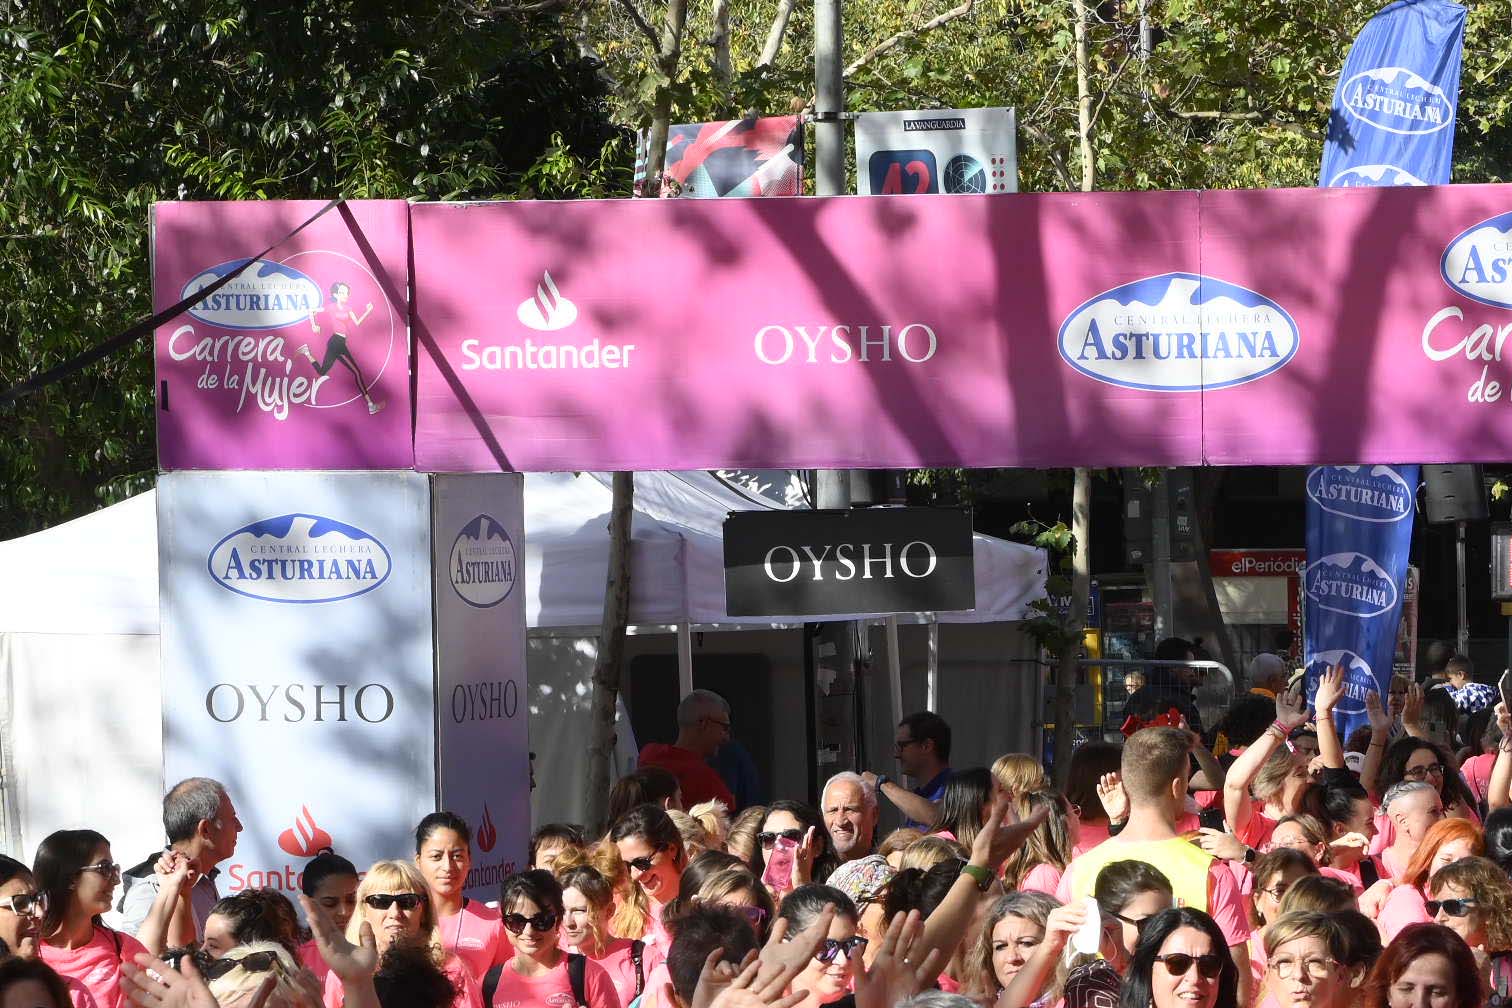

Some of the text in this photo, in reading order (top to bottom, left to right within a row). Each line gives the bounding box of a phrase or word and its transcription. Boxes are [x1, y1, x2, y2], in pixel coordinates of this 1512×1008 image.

[1351, 83, 1442, 123] ASTURIANA
[1077, 317, 1281, 361] ASTURIANA
[1113, 314, 1189, 325] CENTRAL
[167, 324, 286, 363] Carrera
[461, 338, 635, 370] Santander
[754, 323, 938, 364] OYSHO
[198, 358, 330, 420] de la Mujer
[1468, 365, 1501, 403] de
[1315, 474, 1404, 512] ASTURIANA
[222, 547, 378, 580] ASTURIANA
[250, 544, 372, 554] CENTRAL LECHERA
[455, 549, 513, 584] ASTURIANA
[764, 541, 937, 583] OYSHO
[1310, 569, 1387, 608] ASTURIANA
[205, 683, 395, 723] OYSHO
[452, 680, 518, 723] OYSHO
[229, 864, 306, 892] Santa
